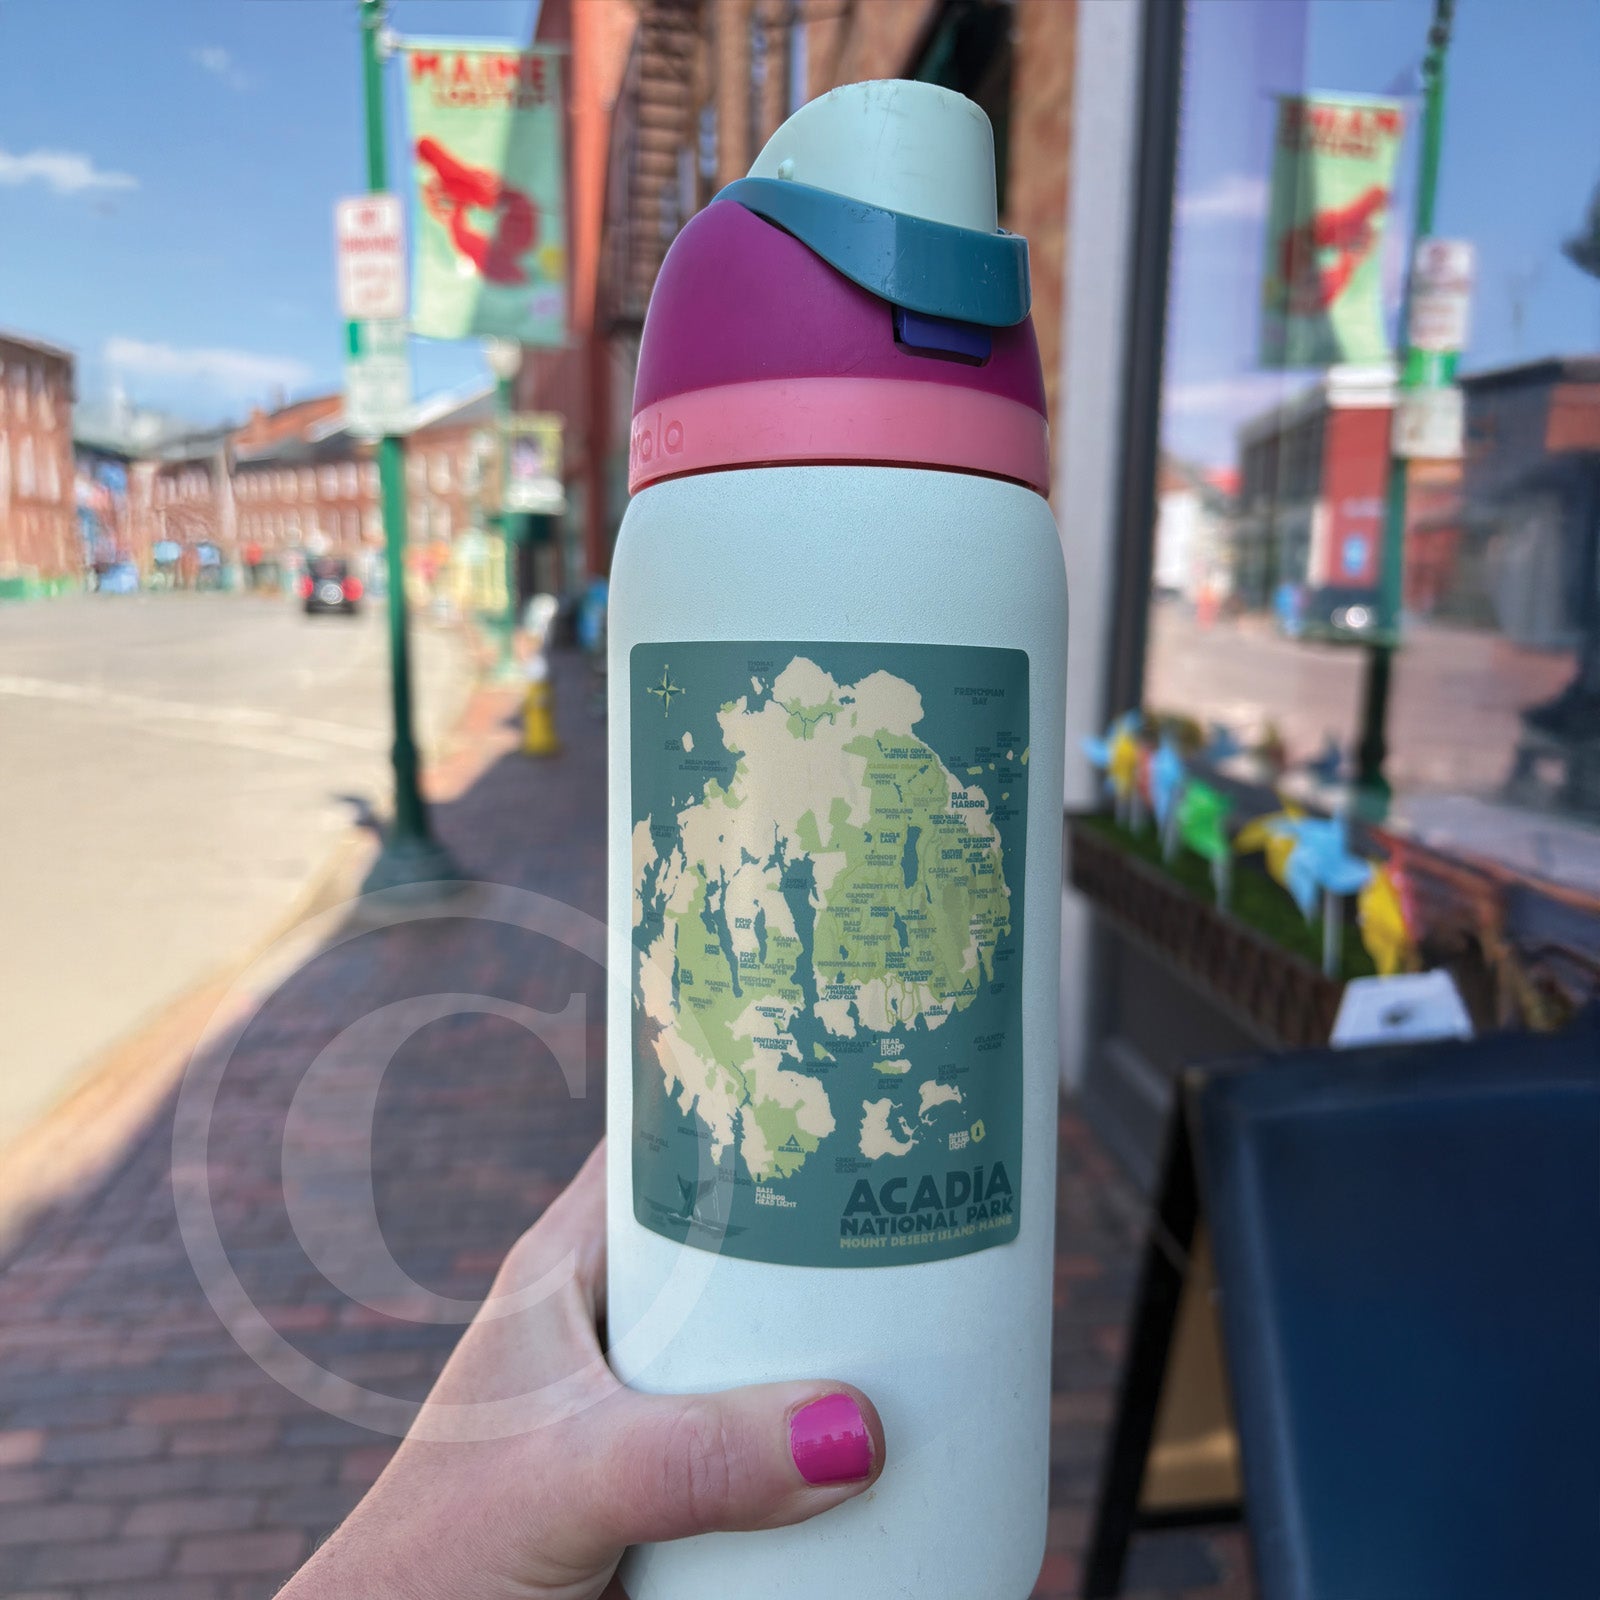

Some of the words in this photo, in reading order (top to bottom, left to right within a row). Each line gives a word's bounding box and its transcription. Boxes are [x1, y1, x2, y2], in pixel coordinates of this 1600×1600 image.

[972, 697, 988, 705] BAY
[951, 792, 968, 800] BAR
[951, 800, 986, 808] HARBOR
[753, 1037, 793, 1045] SOUTHWEST
[756, 1193, 786, 1201] HARBOR
[777, 1200, 798, 1208] LIGHT
[840, 1210, 958, 1236] NATIONAL
[967, 1196, 1015, 1224] PARK
[840, 1236, 886, 1249] MOUNT
[890, 1232, 934, 1247] DESERT
[937, 1225, 976, 1241] ISLAND
[979, 1215, 1013, 1232] MAINE
